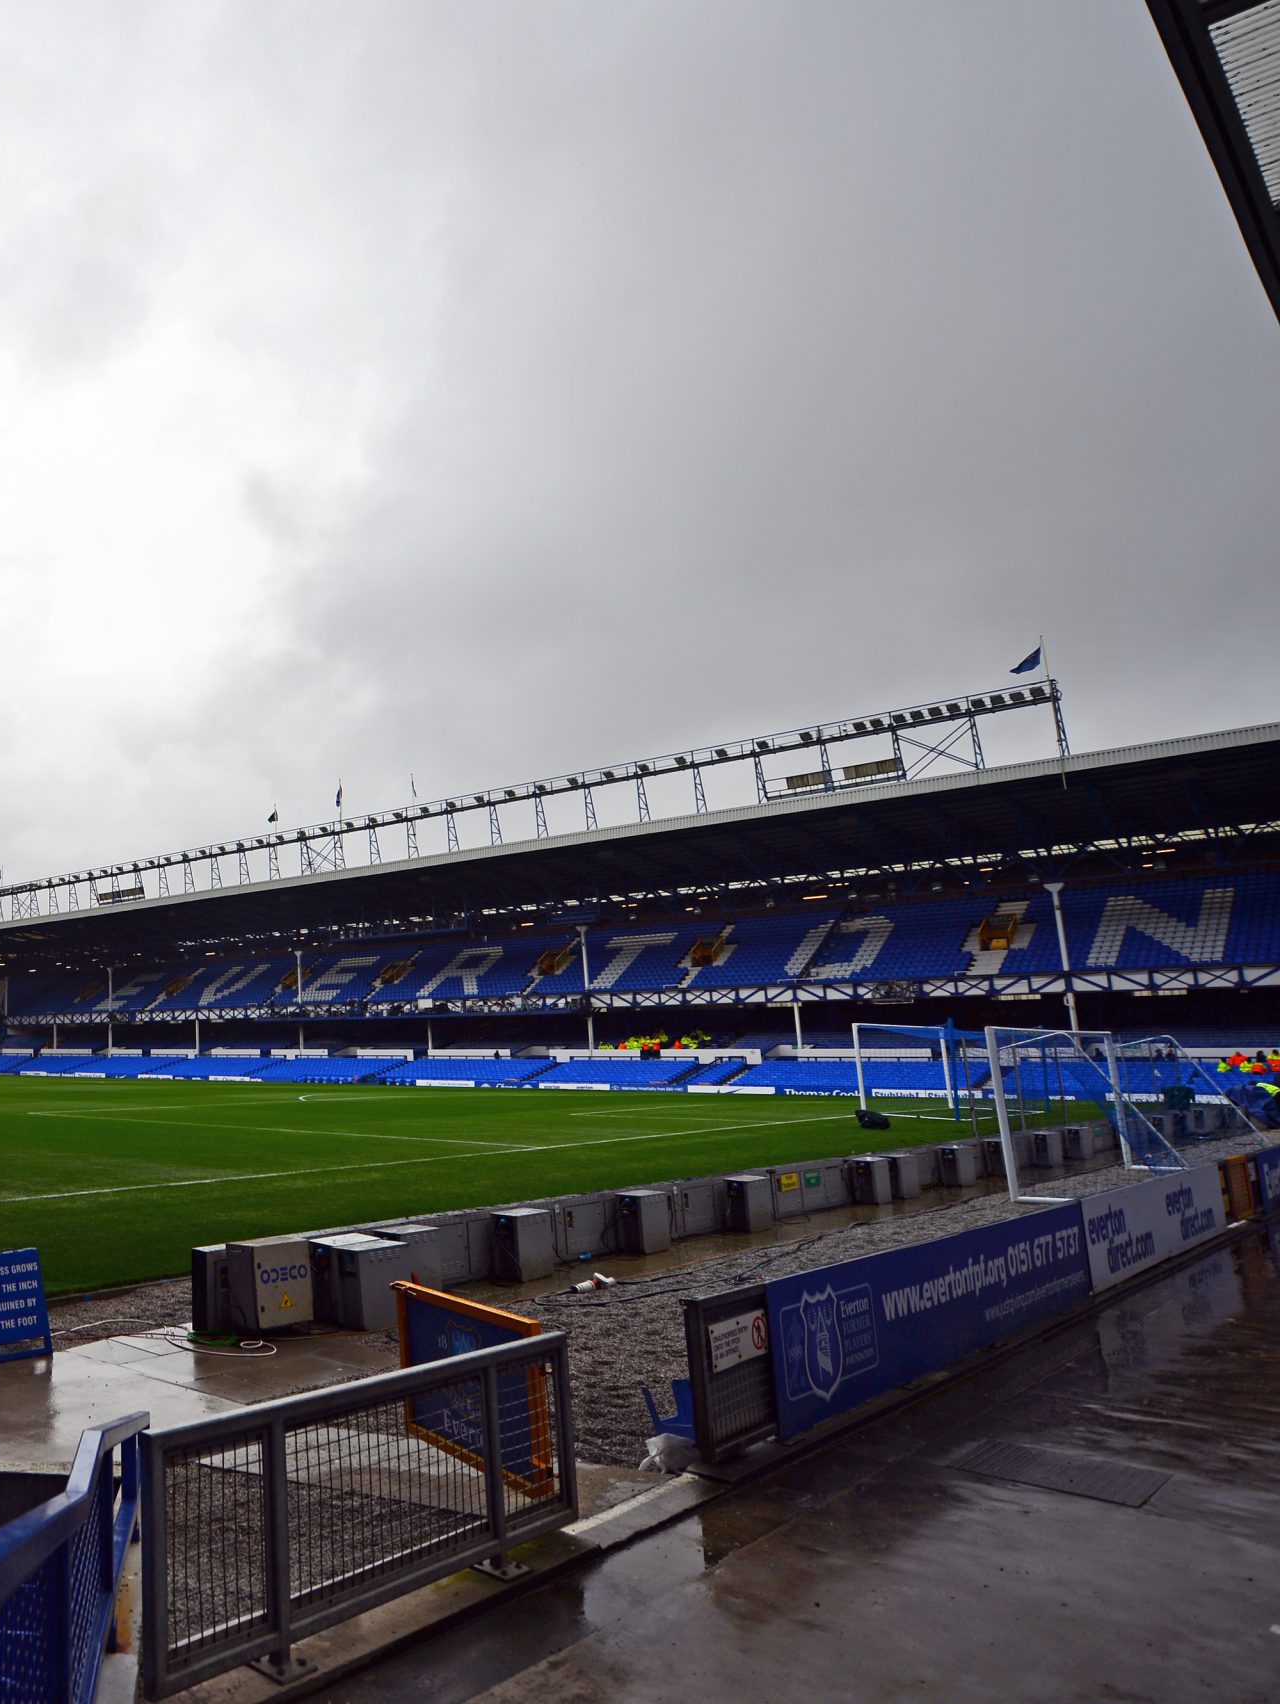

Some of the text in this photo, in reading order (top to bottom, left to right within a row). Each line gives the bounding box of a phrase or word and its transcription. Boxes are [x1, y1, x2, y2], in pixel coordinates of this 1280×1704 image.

[783, 1088, 831, 1096] Thomas
[1165, 1182, 1194, 1217] everton
[1088, 1203, 1126, 1246] everton
[1180, 1207, 1216, 1242] direct.com
[1107, 1232, 1155, 1275] direct.com
[11, 1262, 38, 1274] GROWS
[260, 1264, 308, 1285] ODECO
[881, 1225, 1080, 1322] www.evertonfpf.org 0151 677 5737
[1, 1282, 16, 1293] THE
[18, 1279, 38, 1291] INCH
[27, 1297, 37, 1307] BY
[839, 1297, 869, 1318] Everton
[0, 1315, 37, 1330] THE FOOT
[842, 1314, 871, 1336] FORMER
[845, 1347, 874, 1367] FOUNDATION
